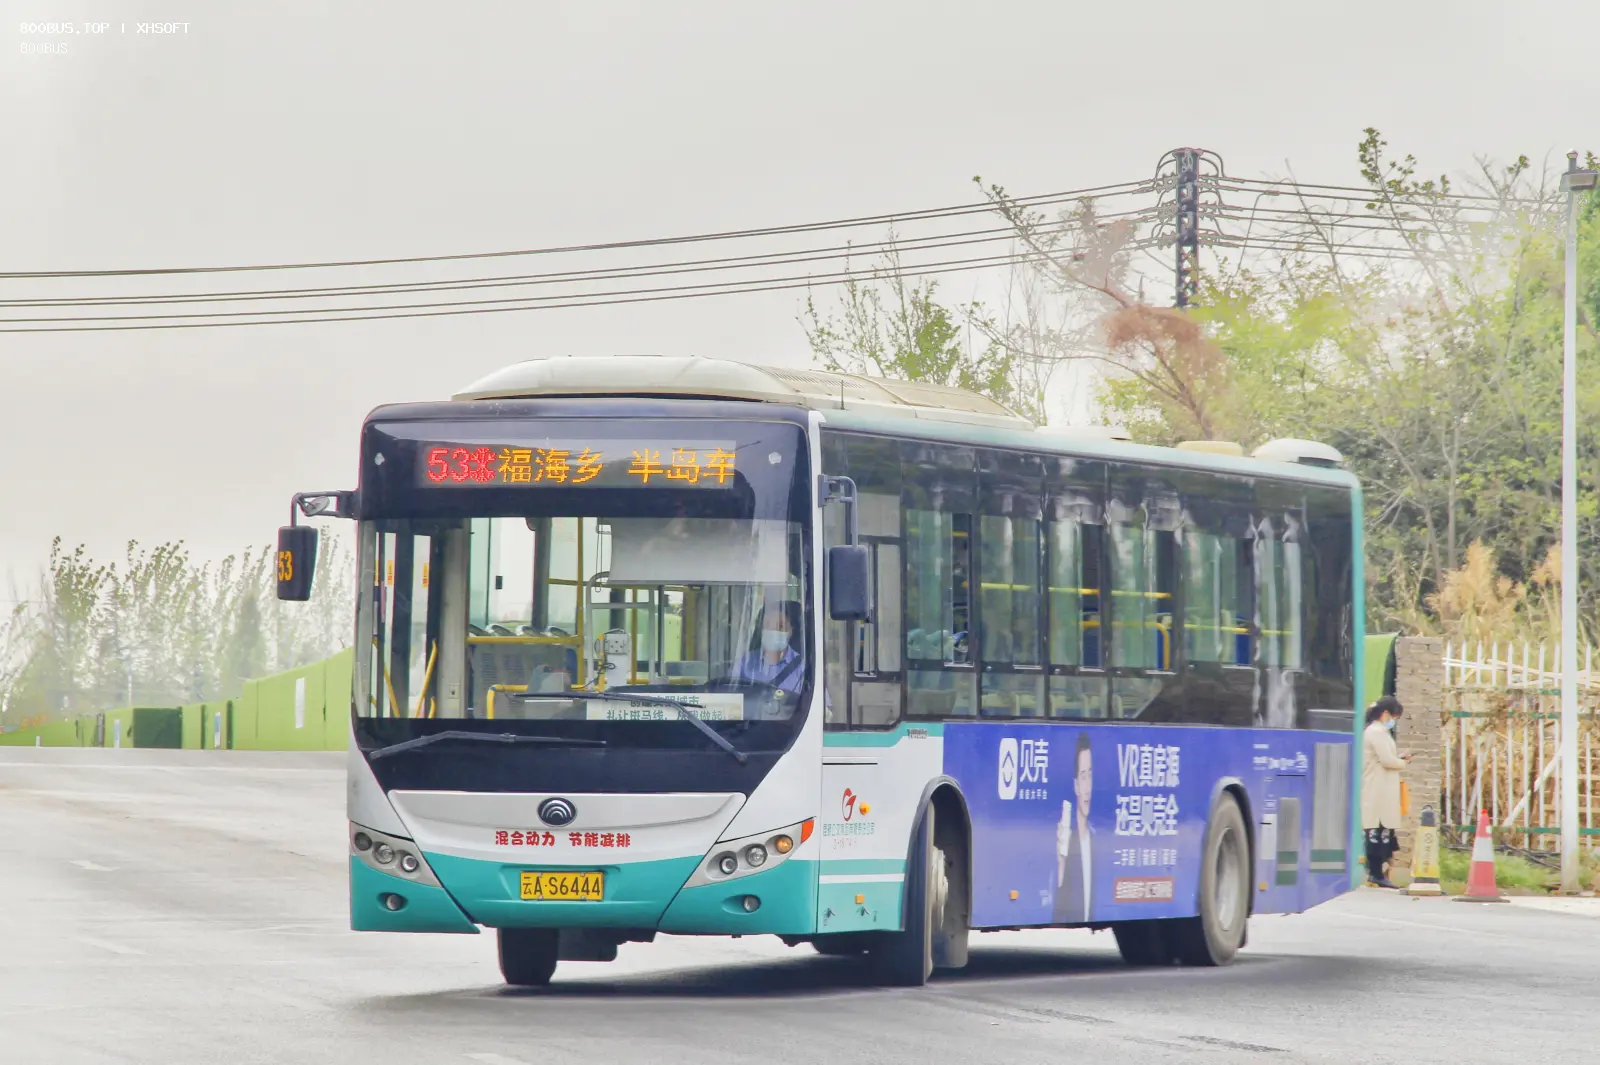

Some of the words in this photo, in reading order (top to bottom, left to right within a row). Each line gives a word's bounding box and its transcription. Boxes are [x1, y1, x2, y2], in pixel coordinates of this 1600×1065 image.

[498, 448, 603, 483] 福海乡
[628, 448, 736, 484] 半岛车
[278, 551, 293, 581] 53
[1019, 739, 1049, 783] 贝壳
[1117, 743, 1181, 788] VR真房源
[1114, 793, 1179, 836] 还是贝壳全
[495, 831, 556, 846] 混合动力
[568, 832, 631, 848] 节能减排
